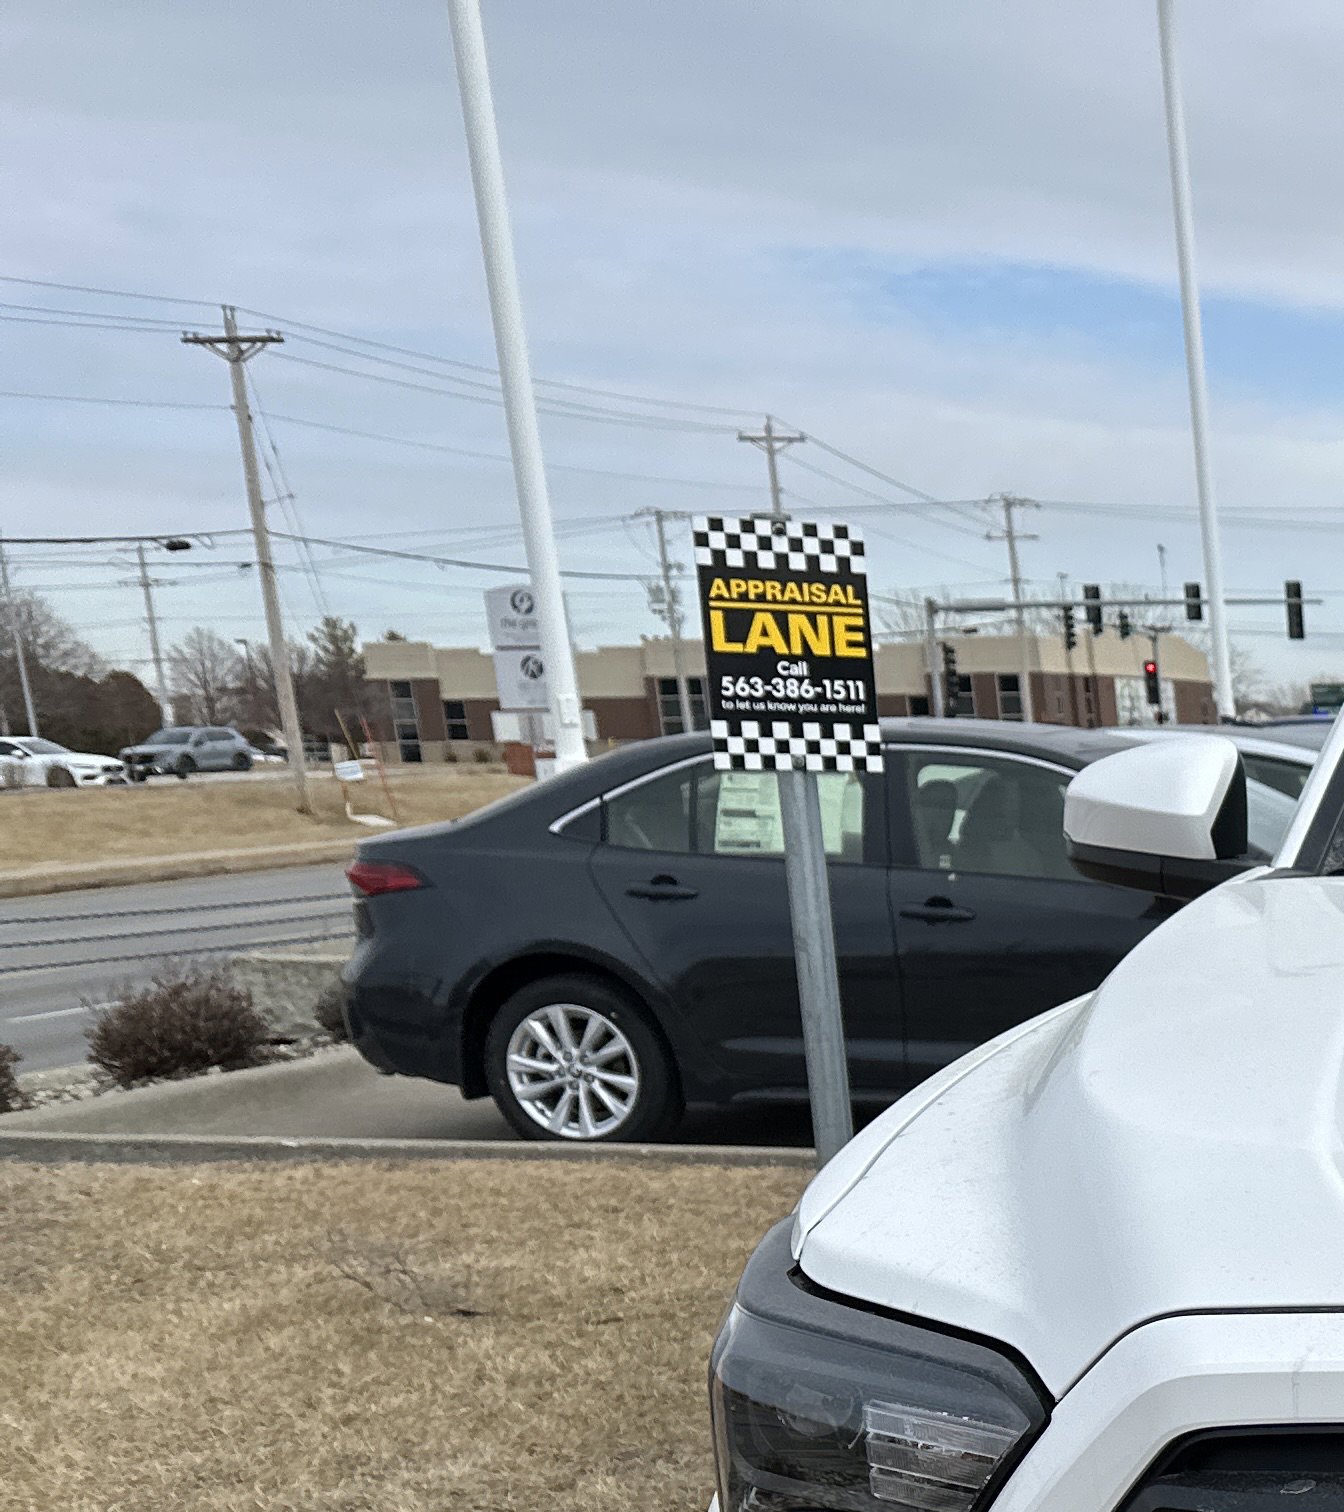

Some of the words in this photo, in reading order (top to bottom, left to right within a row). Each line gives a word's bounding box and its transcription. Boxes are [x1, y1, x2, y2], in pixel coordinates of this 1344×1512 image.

[709, 577, 862, 605] APPRAISAL
[709, 609, 867, 658] LANE
[776, 660, 808, 676] Call
[721, 675, 865, 700] 563-386-1511
[721, 699, 734, 710] to
[735, 699, 751, 710] let
[752, 701, 766, 711] us
[767, 700, 797, 712] know
[798, 702, 818, 714] you
[820, 703, 837, 712] are
[838, 702, 865, 713] here!
